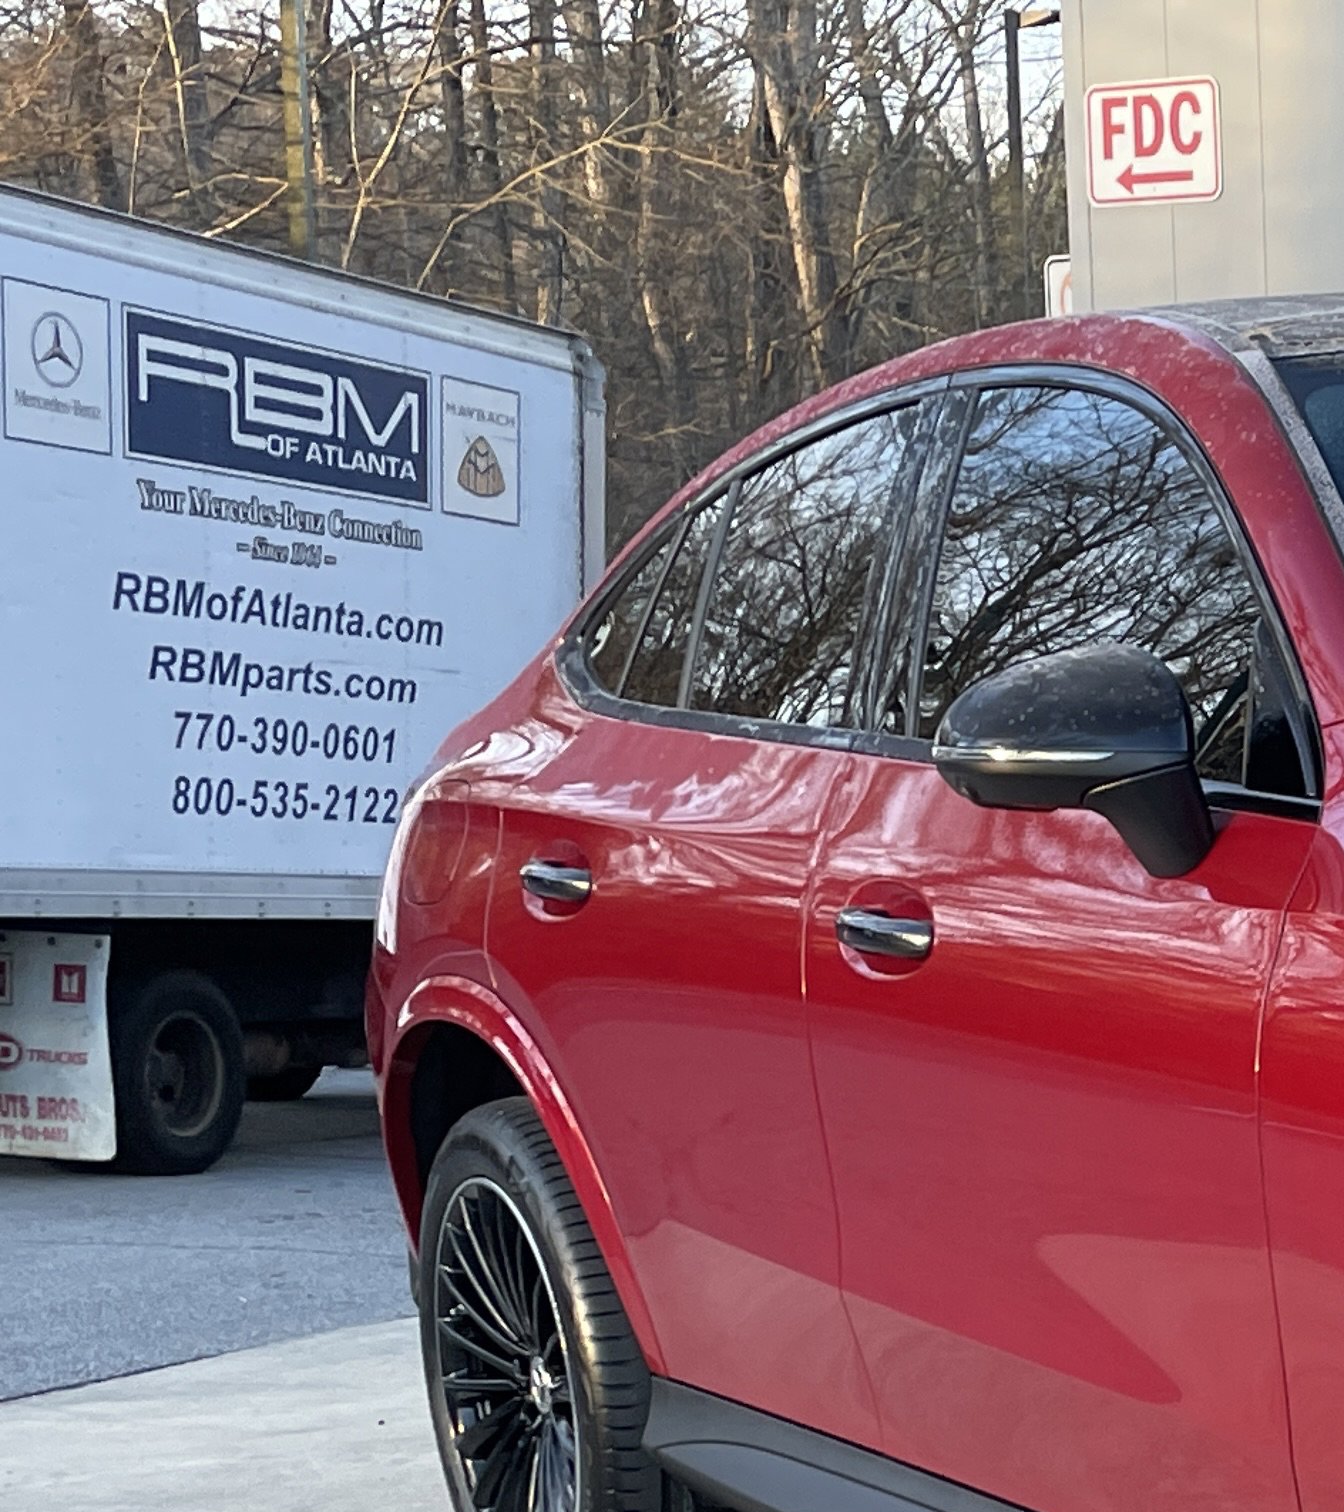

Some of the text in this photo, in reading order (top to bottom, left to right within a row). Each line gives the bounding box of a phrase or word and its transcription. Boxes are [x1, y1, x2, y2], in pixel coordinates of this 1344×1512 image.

[1101, 90, 1202, 160] FDC
[137, 333, 420, 455] RBM
[446, 401, 516, 428] MAYBACH
[267, 433, 418, 483] OF ATLANTA
[137, 478, 424, 551] Your Mercedes-Benz Connection
[251, 535, 290, 564] Since
[112, 571, 445, 648] RBMofAtlanta.com
[149, 645, 418, 704] RBMparts.com
[173, 711, 397, 763] 770-390-0601
[171, 776, 400, 824] 800-535-2122
[26, 1048, 89, 1065] TRUCKS
